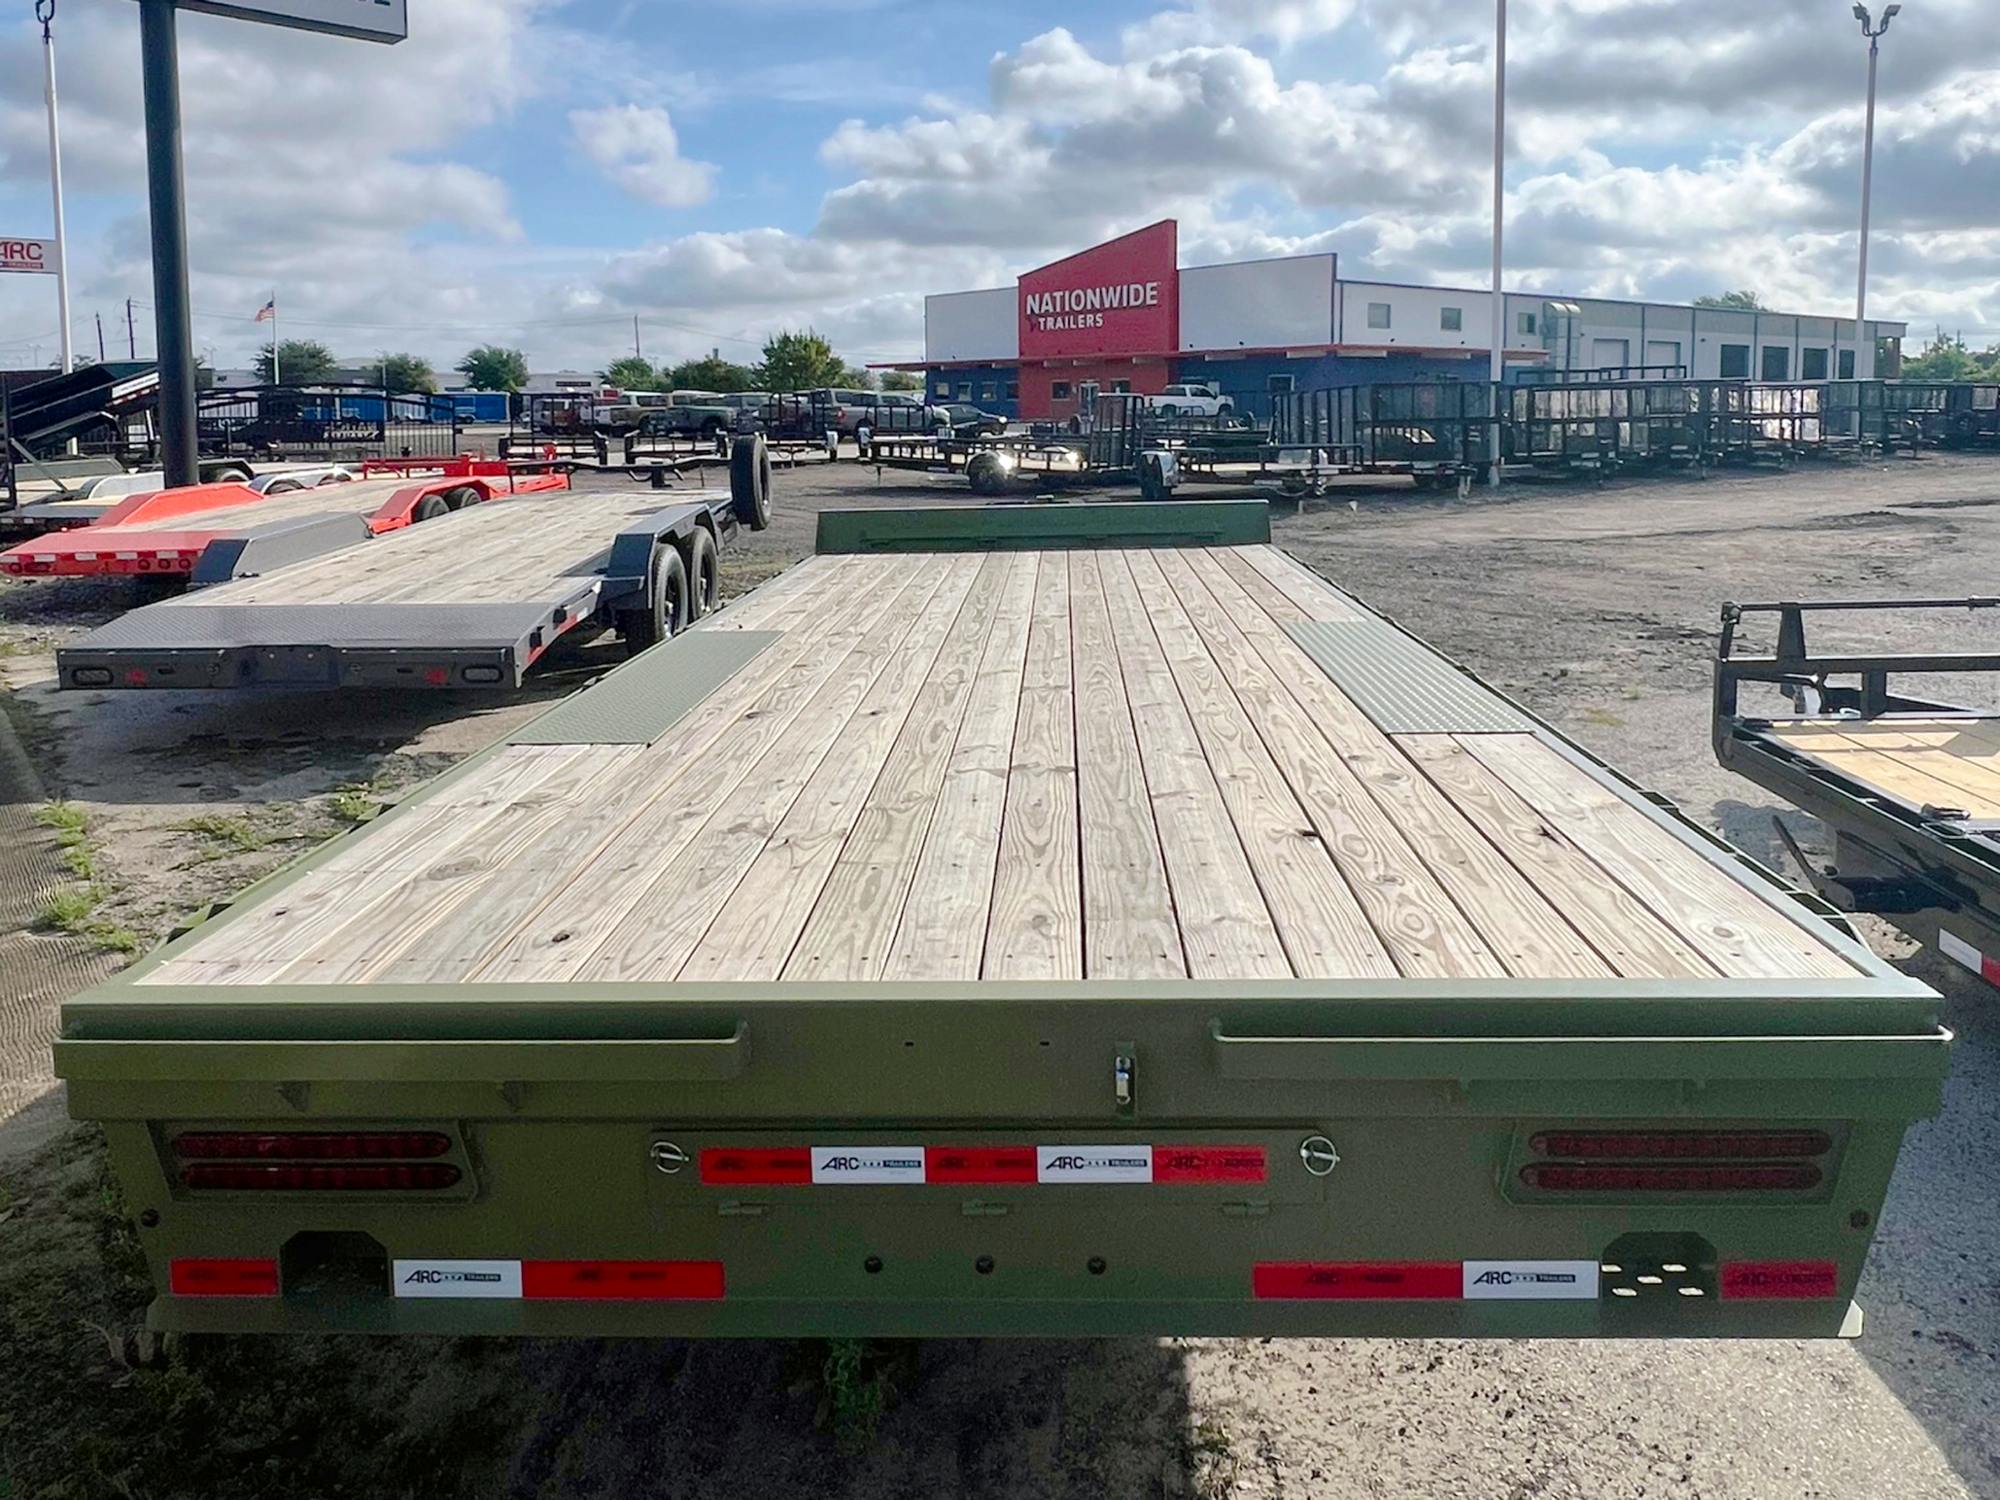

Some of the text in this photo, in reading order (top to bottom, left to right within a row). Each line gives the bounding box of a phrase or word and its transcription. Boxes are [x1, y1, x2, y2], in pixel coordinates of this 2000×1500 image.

[1026, 281, 1158, 315] NATIONWIDE
[1038, 313, 1104, 331] TRAILERS
[821, 1156, 860, 1170] ARC
[1046, 1156, 1085, 1170] ARC
[404, 1269, 441, 1284] ARC
[1473, 1271, 1512, 1285] ARC
